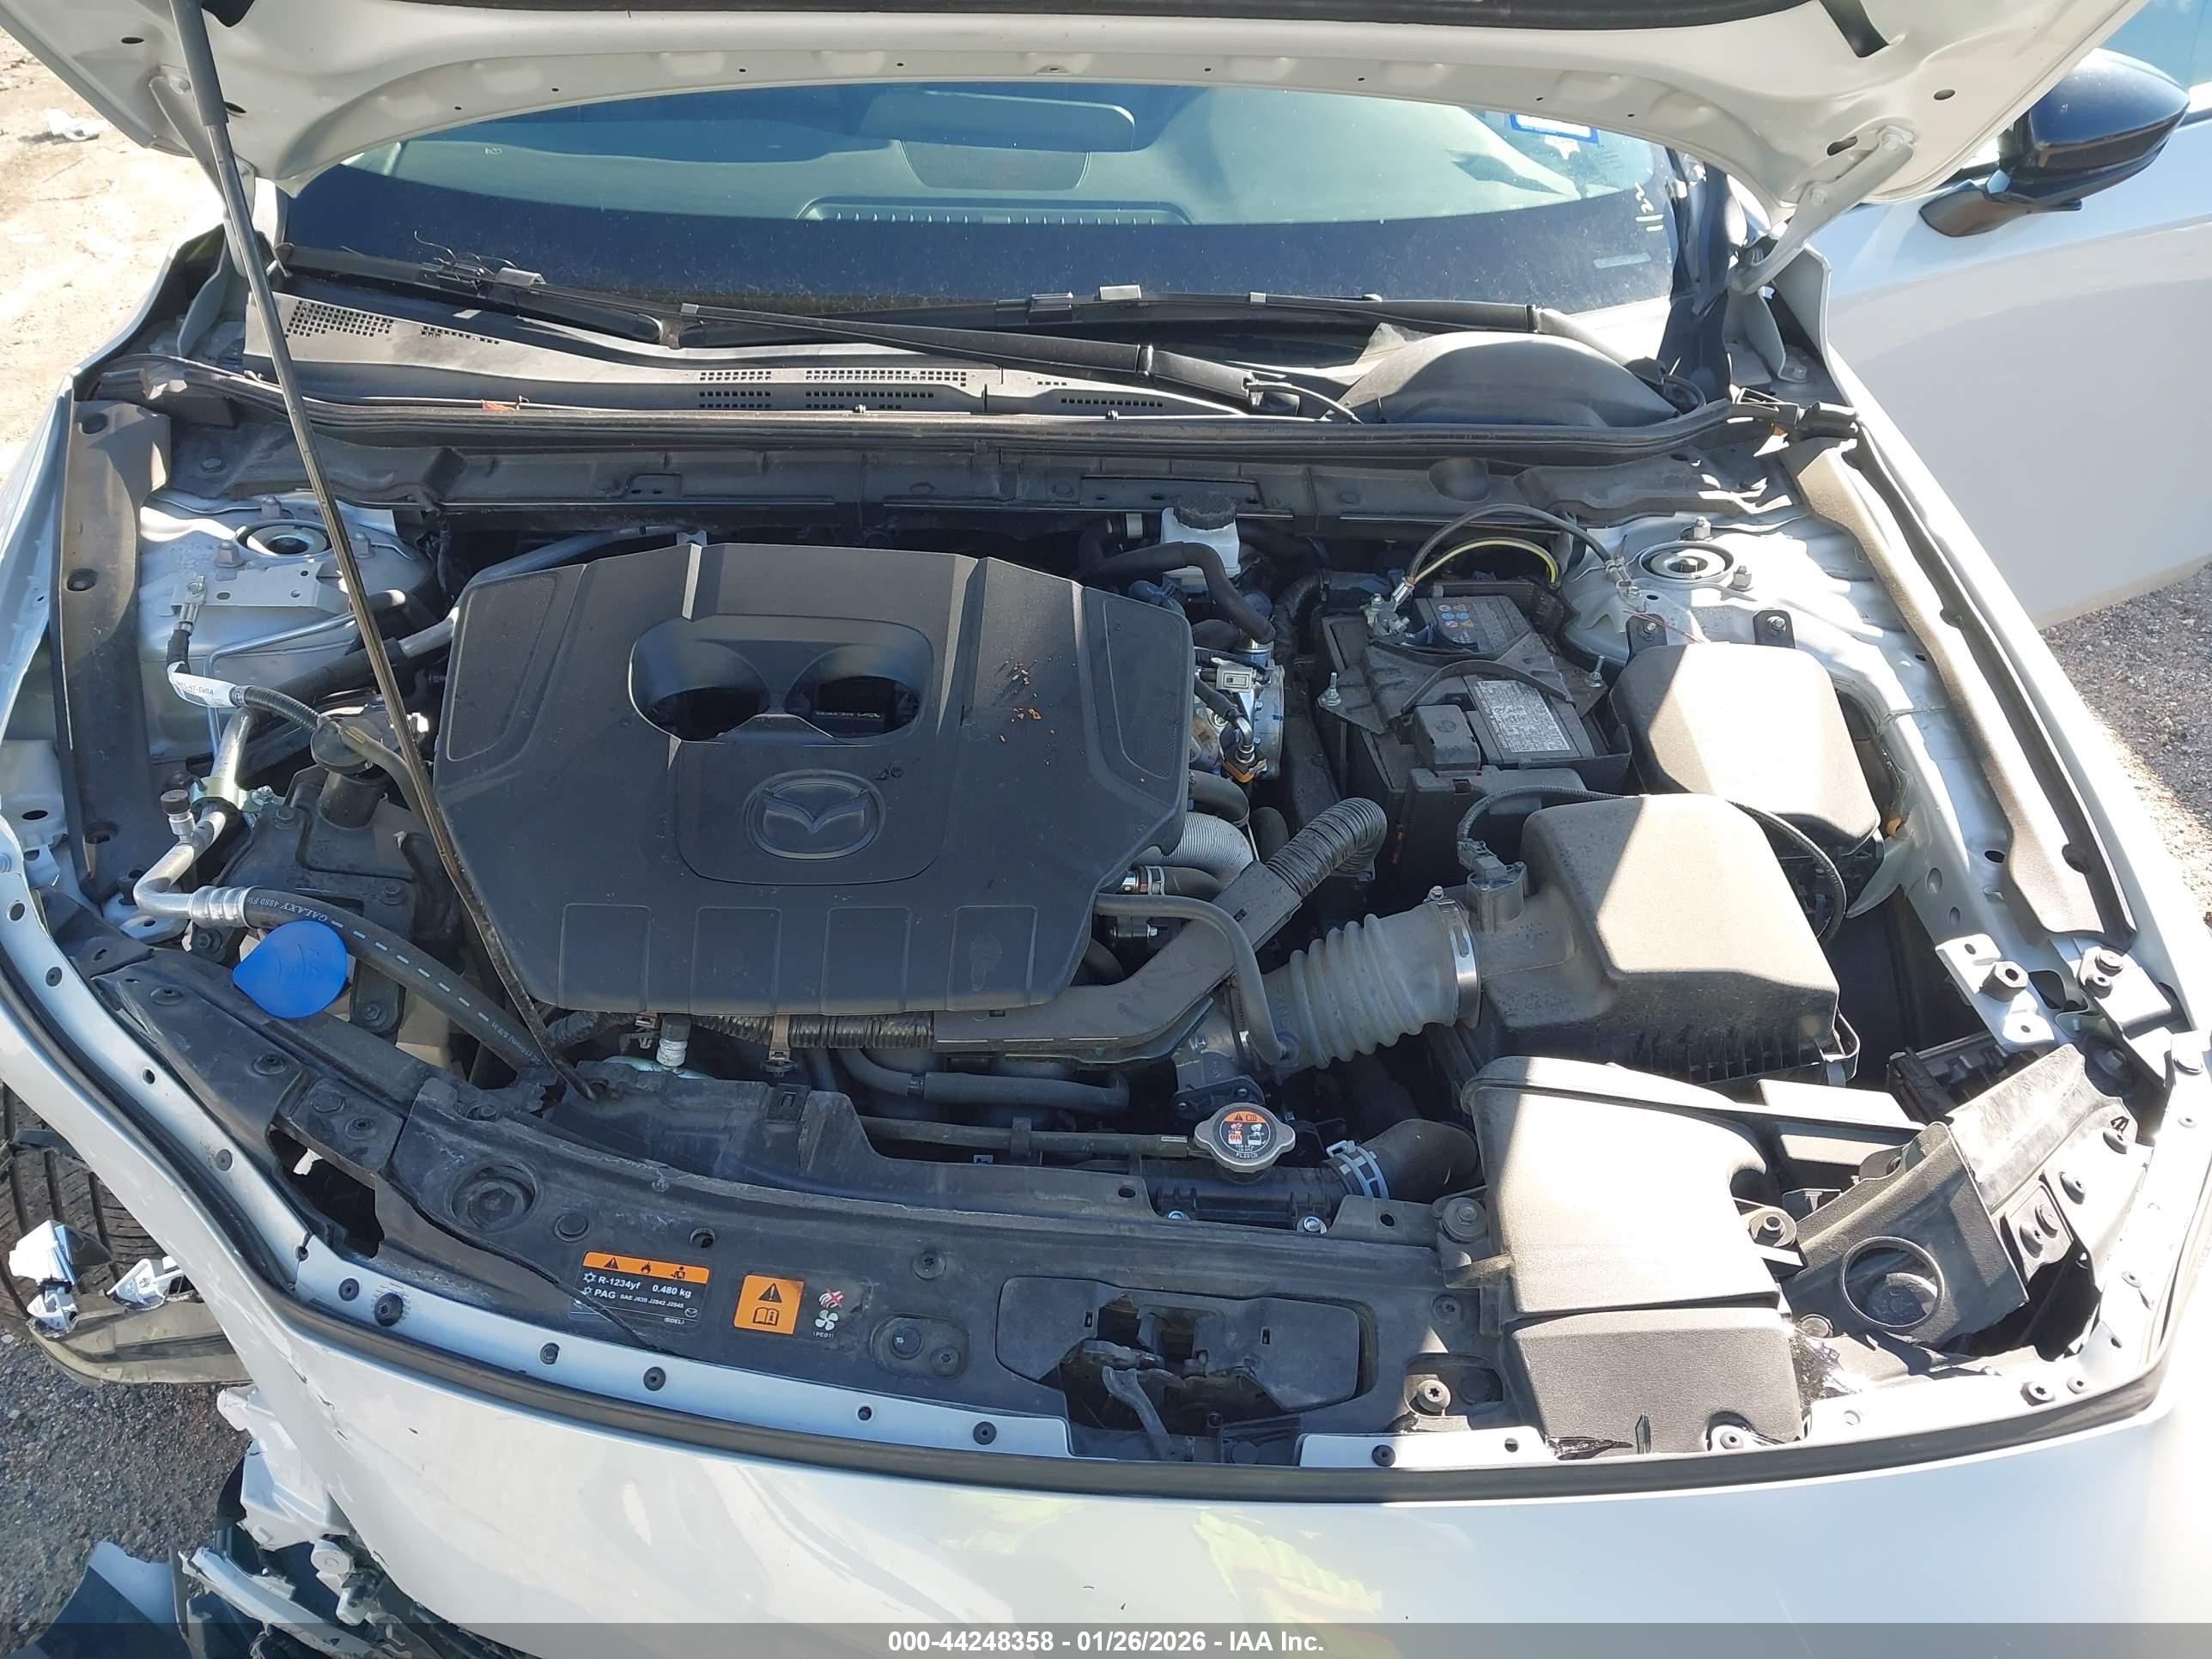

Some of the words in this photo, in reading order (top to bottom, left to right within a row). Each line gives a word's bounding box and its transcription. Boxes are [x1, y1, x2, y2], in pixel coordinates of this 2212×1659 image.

[280, 902, 328, 922] GALAXY
[593, 1288, 616, 1299] PAG
[598, 1275, 641, 1291] R-1234yf
[652, 1284, 678, 1296] 0.480
[678, 1287, 692, 1298] kg
